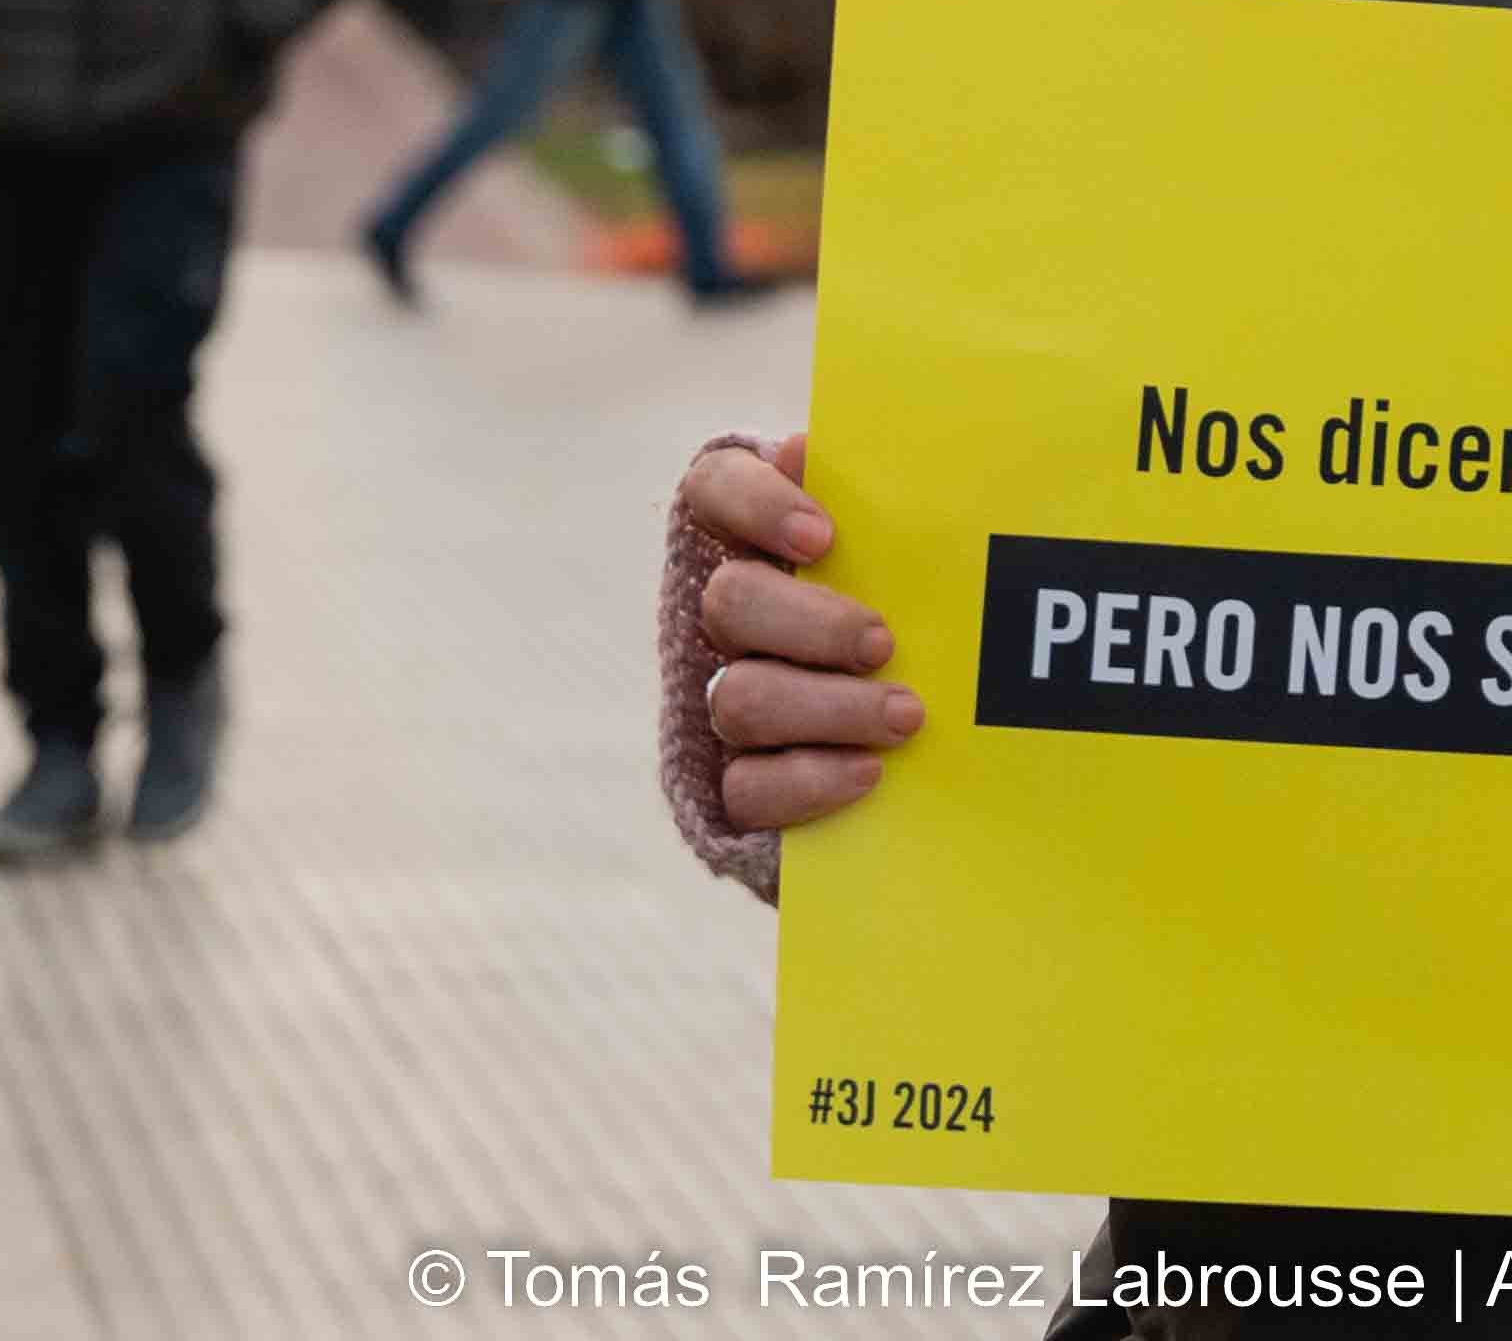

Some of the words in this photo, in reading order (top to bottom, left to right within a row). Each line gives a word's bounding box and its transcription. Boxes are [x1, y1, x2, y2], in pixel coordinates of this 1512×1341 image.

[1136, 385, 1287, 483] Nos
[1031, 588, 1257, 693] PERO
[1288, 604, 1455, 704] NOS
[808, 1077, 877, 1129] #3J
[893, 1081, 997, 1135] 2024
